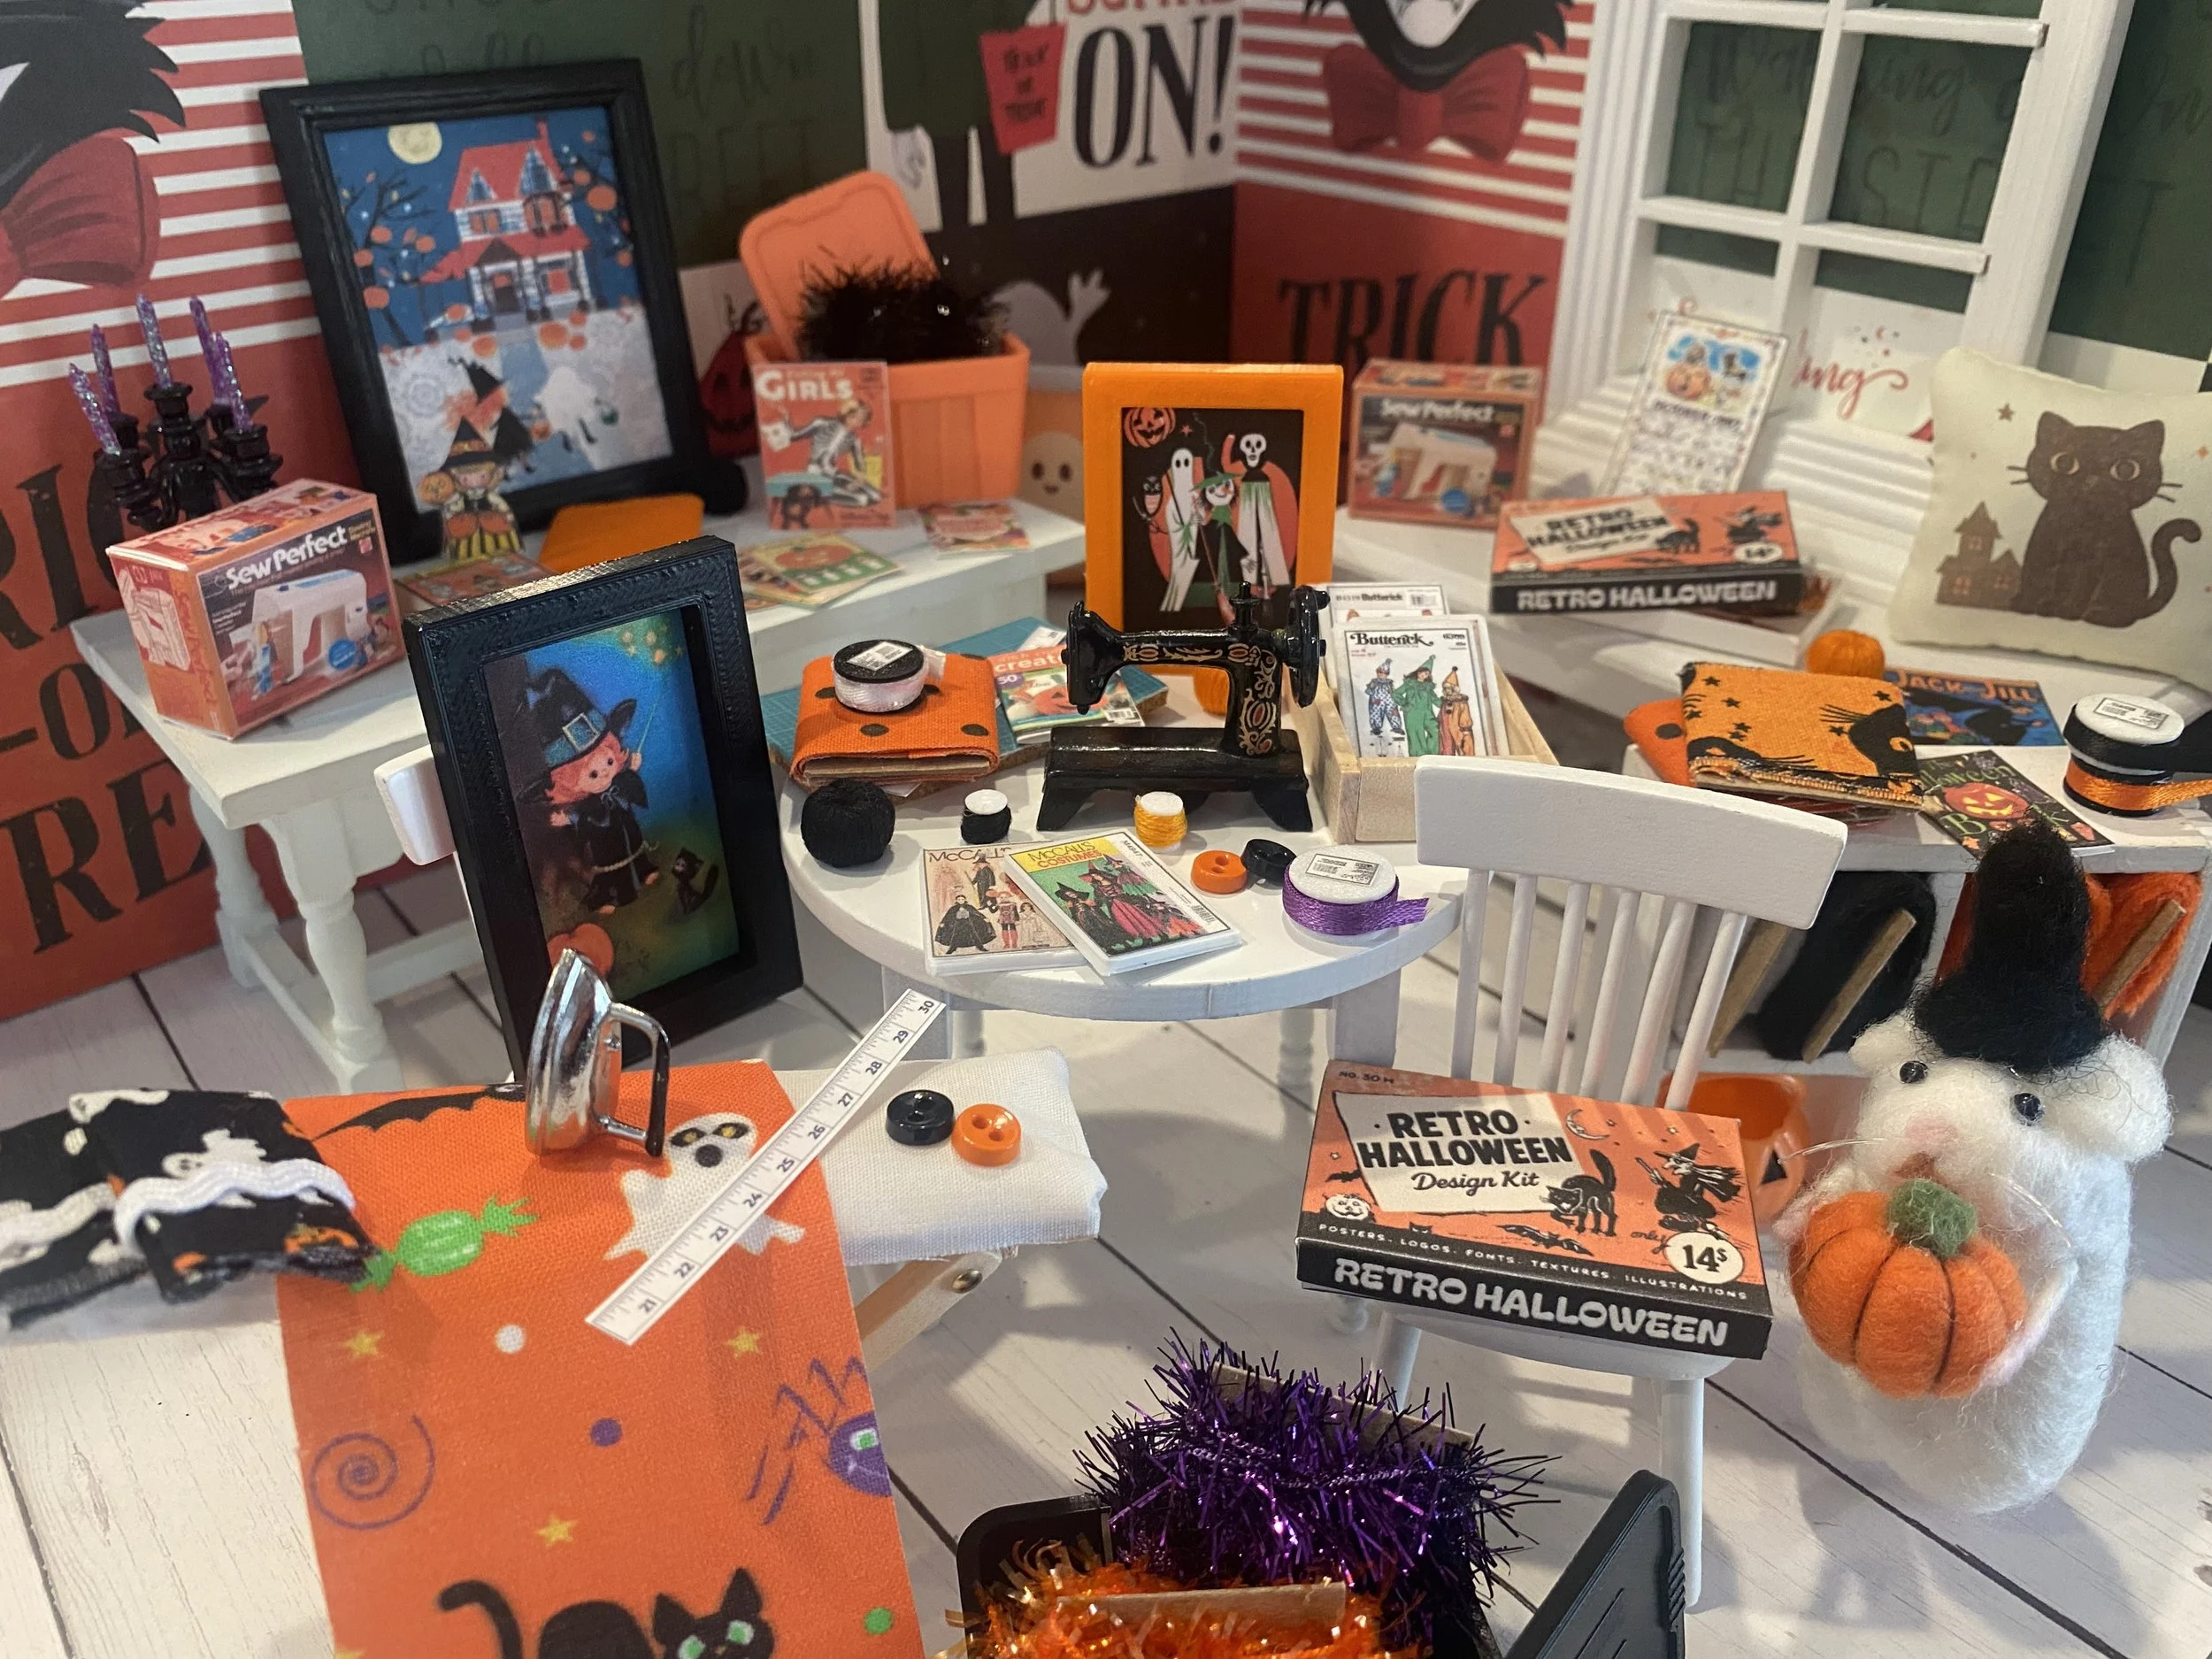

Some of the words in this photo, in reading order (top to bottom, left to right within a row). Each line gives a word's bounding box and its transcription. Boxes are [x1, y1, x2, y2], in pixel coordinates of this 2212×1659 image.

[1073, 13, 1235, 168] ON!
[1279, 268, 1547, 365] TRICK
[754, 369, 854, 401] GIRLS
[227, 558, 273, 590] Sew
[273, 526, 348, 572] Perfect
[1517, 588, 1606, 611] RETRO
[1609, 580, 1778, 608] HALLOWEEN
[1350, 633, 1434, 647] Butterick
[995, 653, 1065, 672] creat
[1037, 849, 1103, 868] COSTUMES
[1386, 1109, 1519, 1139] RETRO
[639, 1298, 657, 1314] 21
[674, 1261, 695, 1279] 22
[710, 1225, 730, 1243] 23
[743, 1192, 763, 1209] 24
[776, 1156, 795, 1173] 25
[807, 1125, 826, 1141] 26
[837, 1091, 855, 1108] 27
[865, 1060, 883, 1076] 28
[893, 1029, 910, 1045] 29
[918, 1000, 935, 1015] 30
[1356, 1135, 1573, 1169] HALLOWEEN
[1410, 1171, 1498, 1197] Design
[1501, 1170, 1541, 1187] Kit
[1334, 1257, 1468, 1305] RETRO
[1473, 1282, 1729, 1347] HALLOWEEN
[1624, 1273, 1747, 1301] ILLUSTRATIONS
